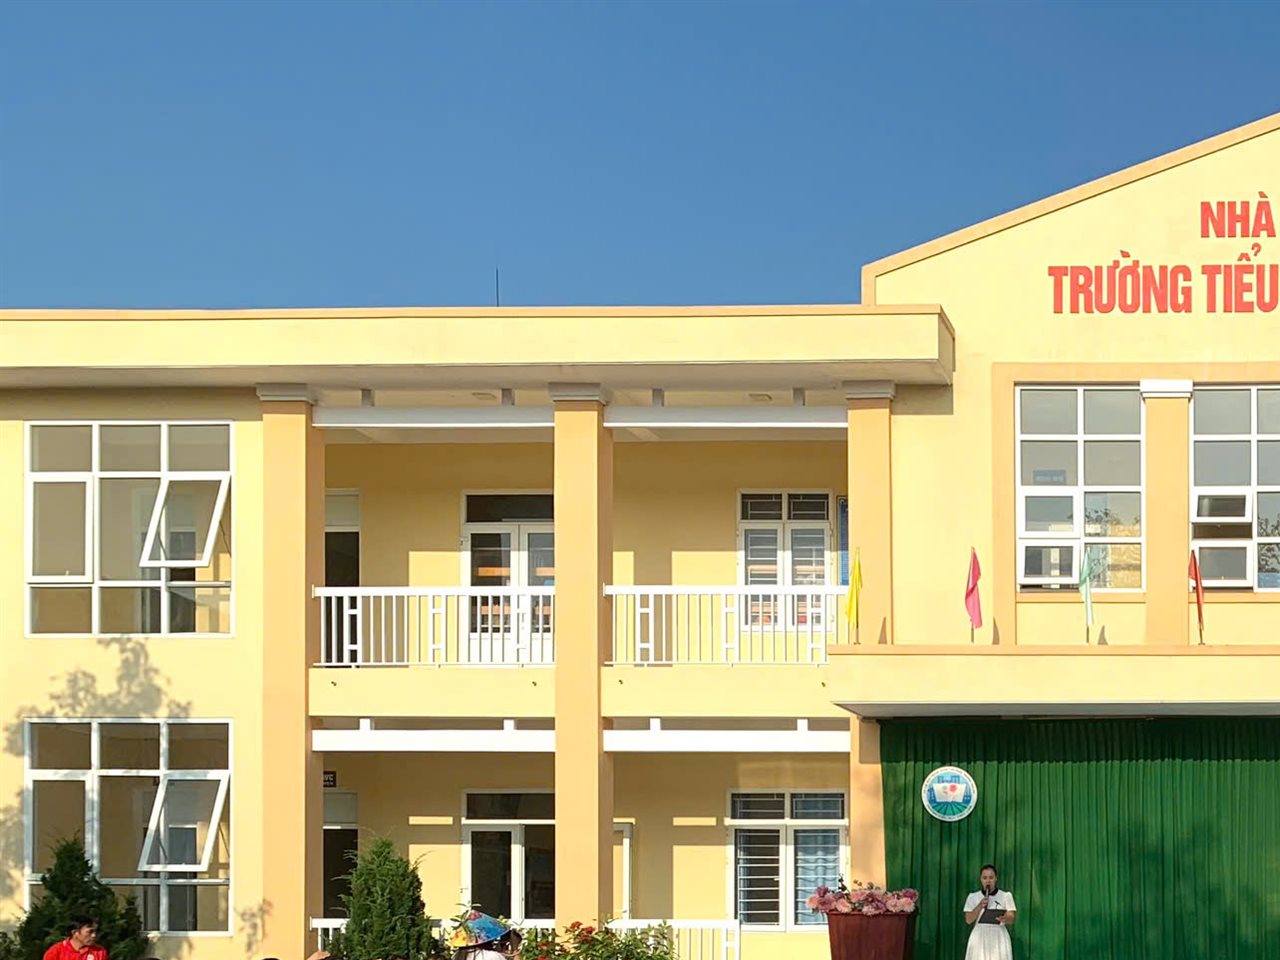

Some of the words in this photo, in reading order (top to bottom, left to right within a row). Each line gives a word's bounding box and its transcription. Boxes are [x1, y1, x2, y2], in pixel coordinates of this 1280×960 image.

[1200, 191, 1276, 238] NHÀ
[1048, 250, 1192, 314] TRƯỜNG
[1201, 242, 1279, 314] TIỂU
